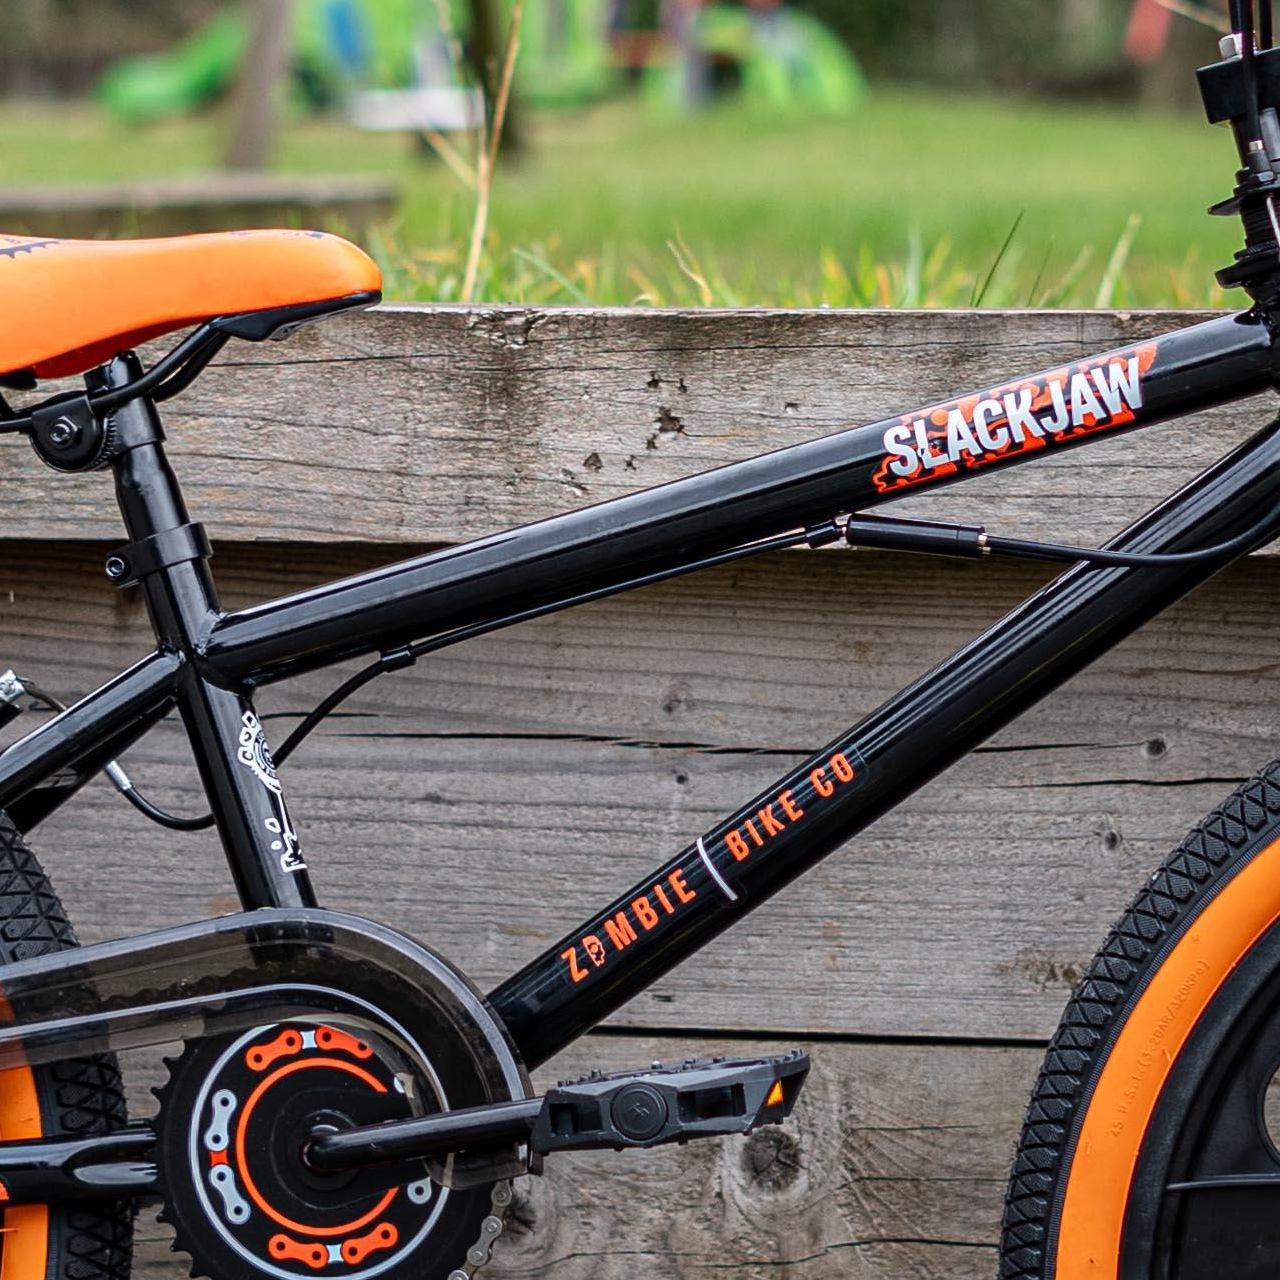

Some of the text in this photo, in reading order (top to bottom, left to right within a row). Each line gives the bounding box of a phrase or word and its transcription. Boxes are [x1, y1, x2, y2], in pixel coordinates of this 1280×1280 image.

[883, 357, 1143, 478] SLACKJAW
[560, 752, 855, 983] ZOMBIE BIKE CO
